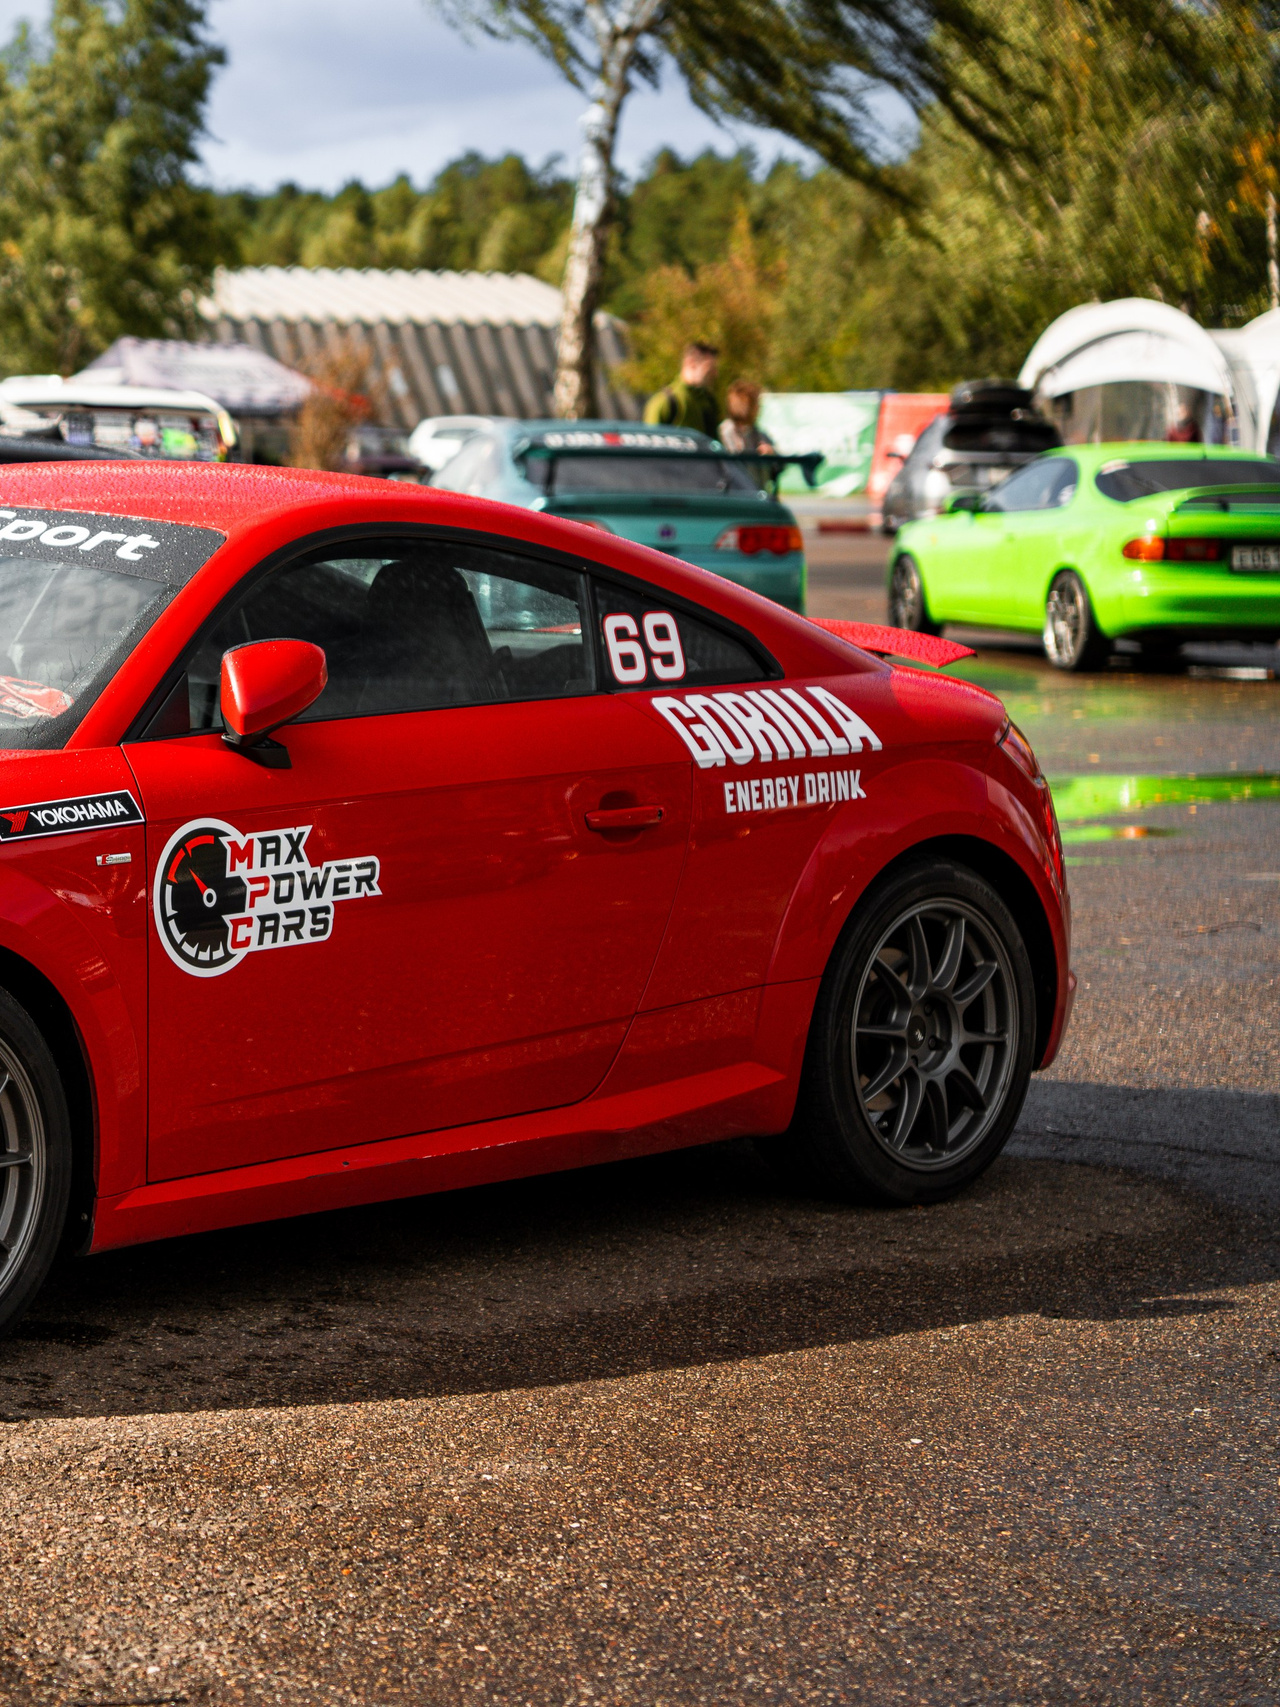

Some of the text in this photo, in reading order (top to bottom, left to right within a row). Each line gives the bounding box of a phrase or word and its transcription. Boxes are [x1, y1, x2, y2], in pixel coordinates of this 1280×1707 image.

[603, 610, 687, 685] 69
[651, 686, 883, 769] GORILLA
[29, 799, 129, 827] YOKOHAMA
[724, 769, 867, 813] ENERGY DRINK
[226, 831, 306, 873] MAX
[246, 860, 377, 909] POWER
[229, 905, 331, 950] CARS
